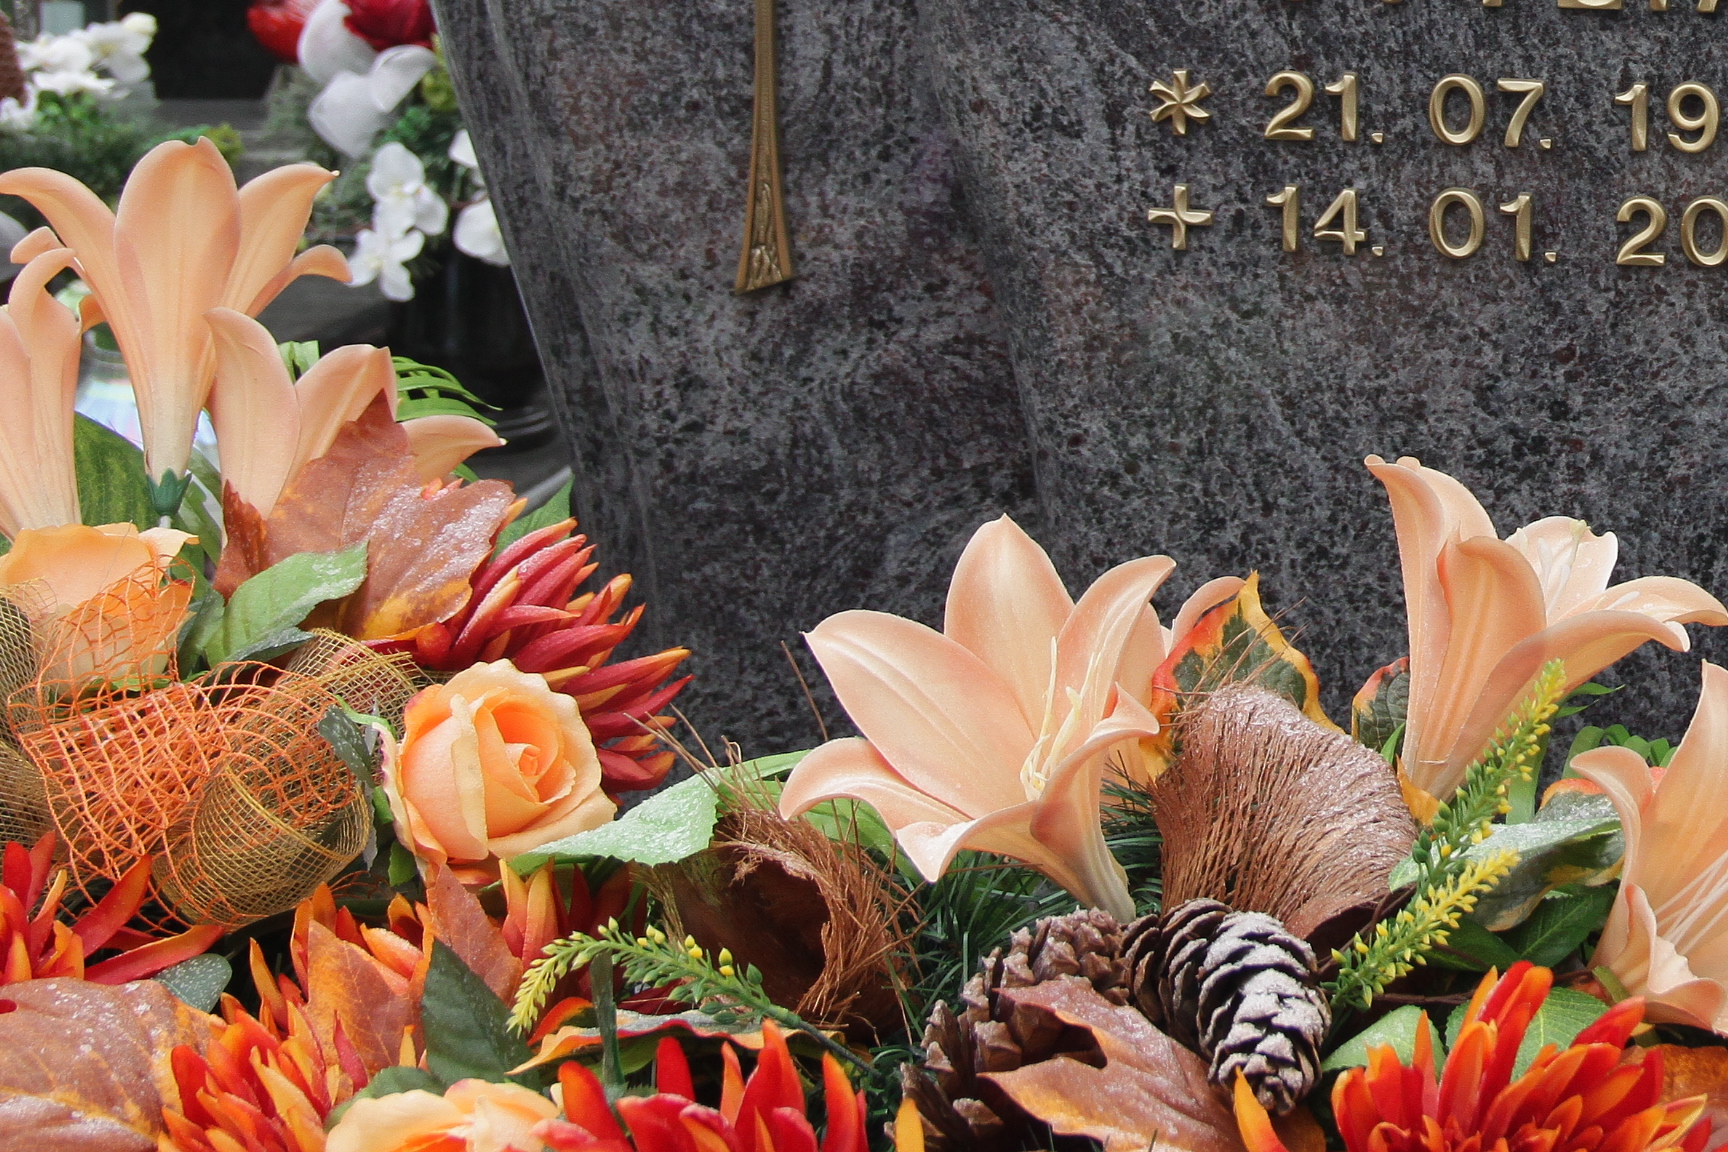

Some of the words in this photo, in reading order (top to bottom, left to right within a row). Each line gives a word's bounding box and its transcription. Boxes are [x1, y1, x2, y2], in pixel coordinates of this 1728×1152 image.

[1263, 70, 1385, 145] 21.
[1428, 73, 1554, 151] 07.
[1265, 183, 1386, 258] 14.
[1427, 187, 1559, 264] 01.
